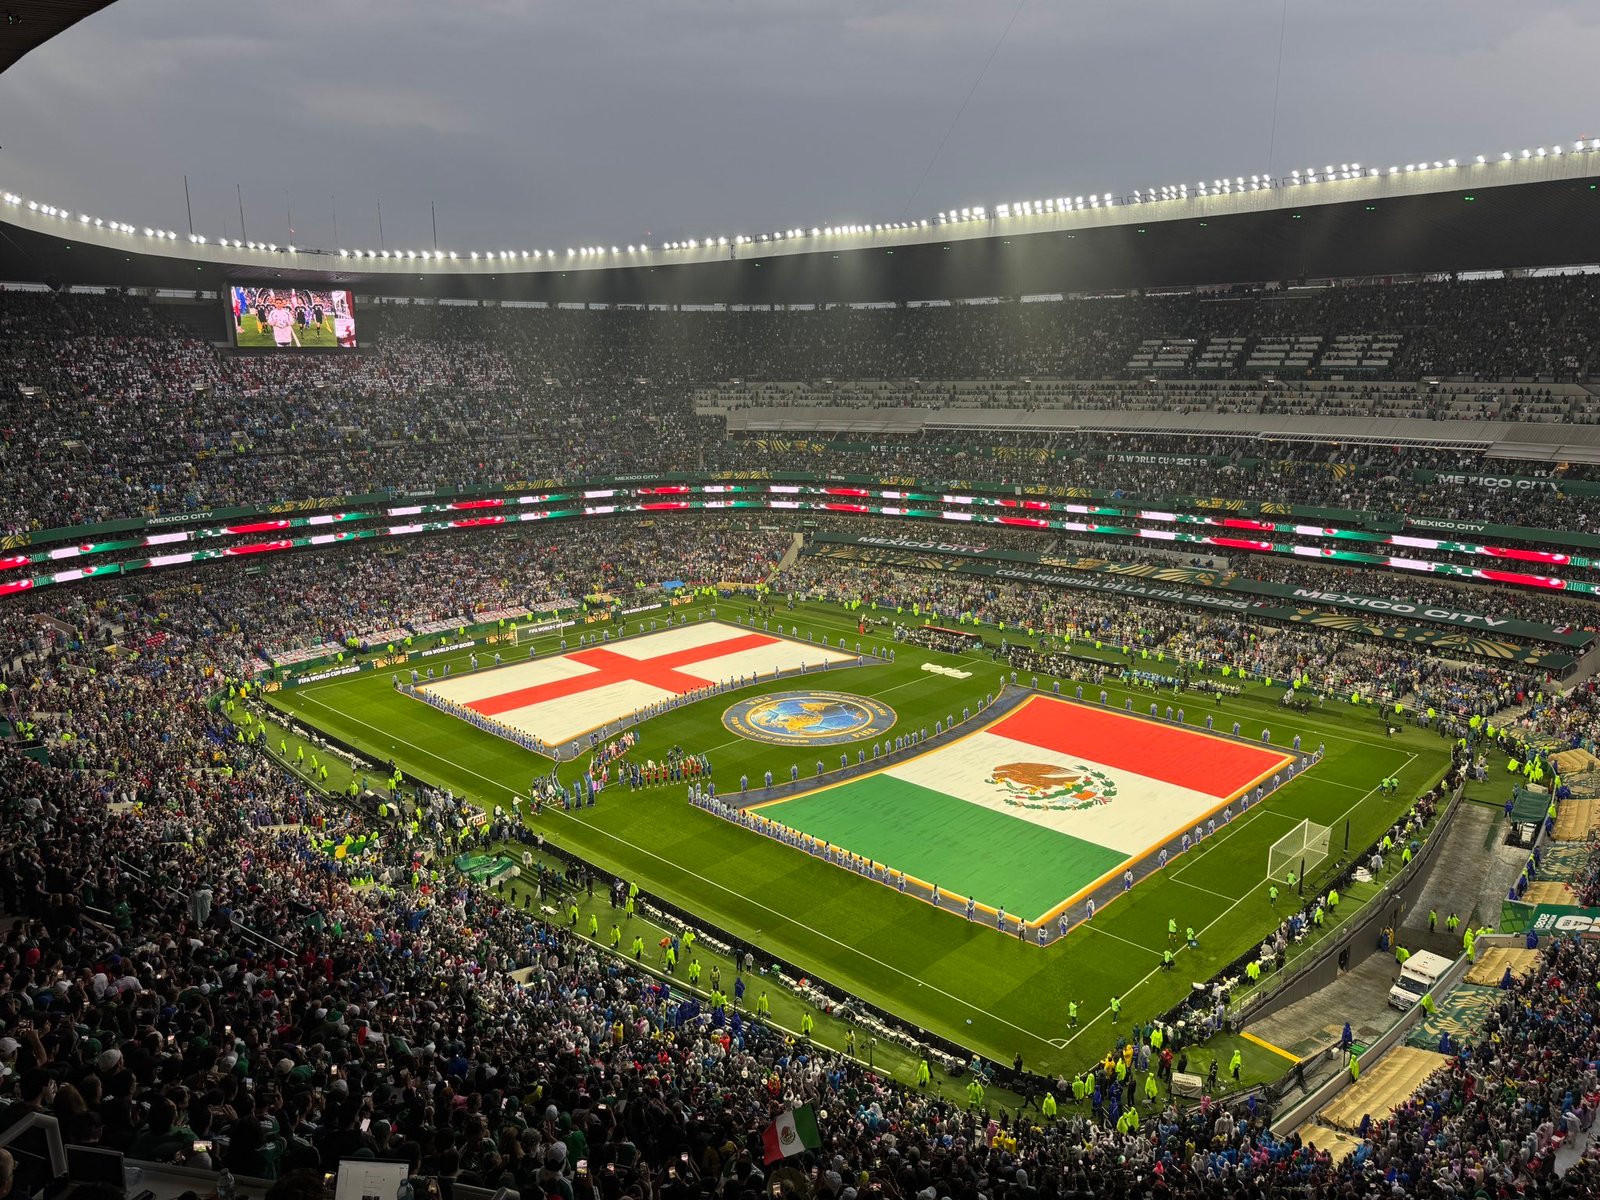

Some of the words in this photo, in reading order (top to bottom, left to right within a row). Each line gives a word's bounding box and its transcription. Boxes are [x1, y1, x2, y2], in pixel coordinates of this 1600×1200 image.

[149, 515, 189, 525] MEXICO
[190, 512, 214, 520] CITY
[1411, 519, 1455, 529] MEXICO
[1456, 523, 1485, 532] CITY
[857, 536, 935, 549] MEXICO
[995, 569, 1033, 579] COPA
[1034, 574, 1100, 588] MUNDIAL
[1102, 582, 1126, 591] DE
[1125, 585, 1147, 594] LA
[1147, 588, 1184, 600] FIFA
[1186, 594, 1250, 609] 2026
[1293, 588, 1416, 613] MEXICO
[1423, 609, 1510, 627] CITY
[432, 646, 450, 654] WORLD
[298, 677, 311, 685] FIFA
[310, 672, 331, 682] WORLD
[330, 670, 342, 678] CUP
[341, 665, 361, 675] 2026
[851, 728, 879, 739] FIFA
